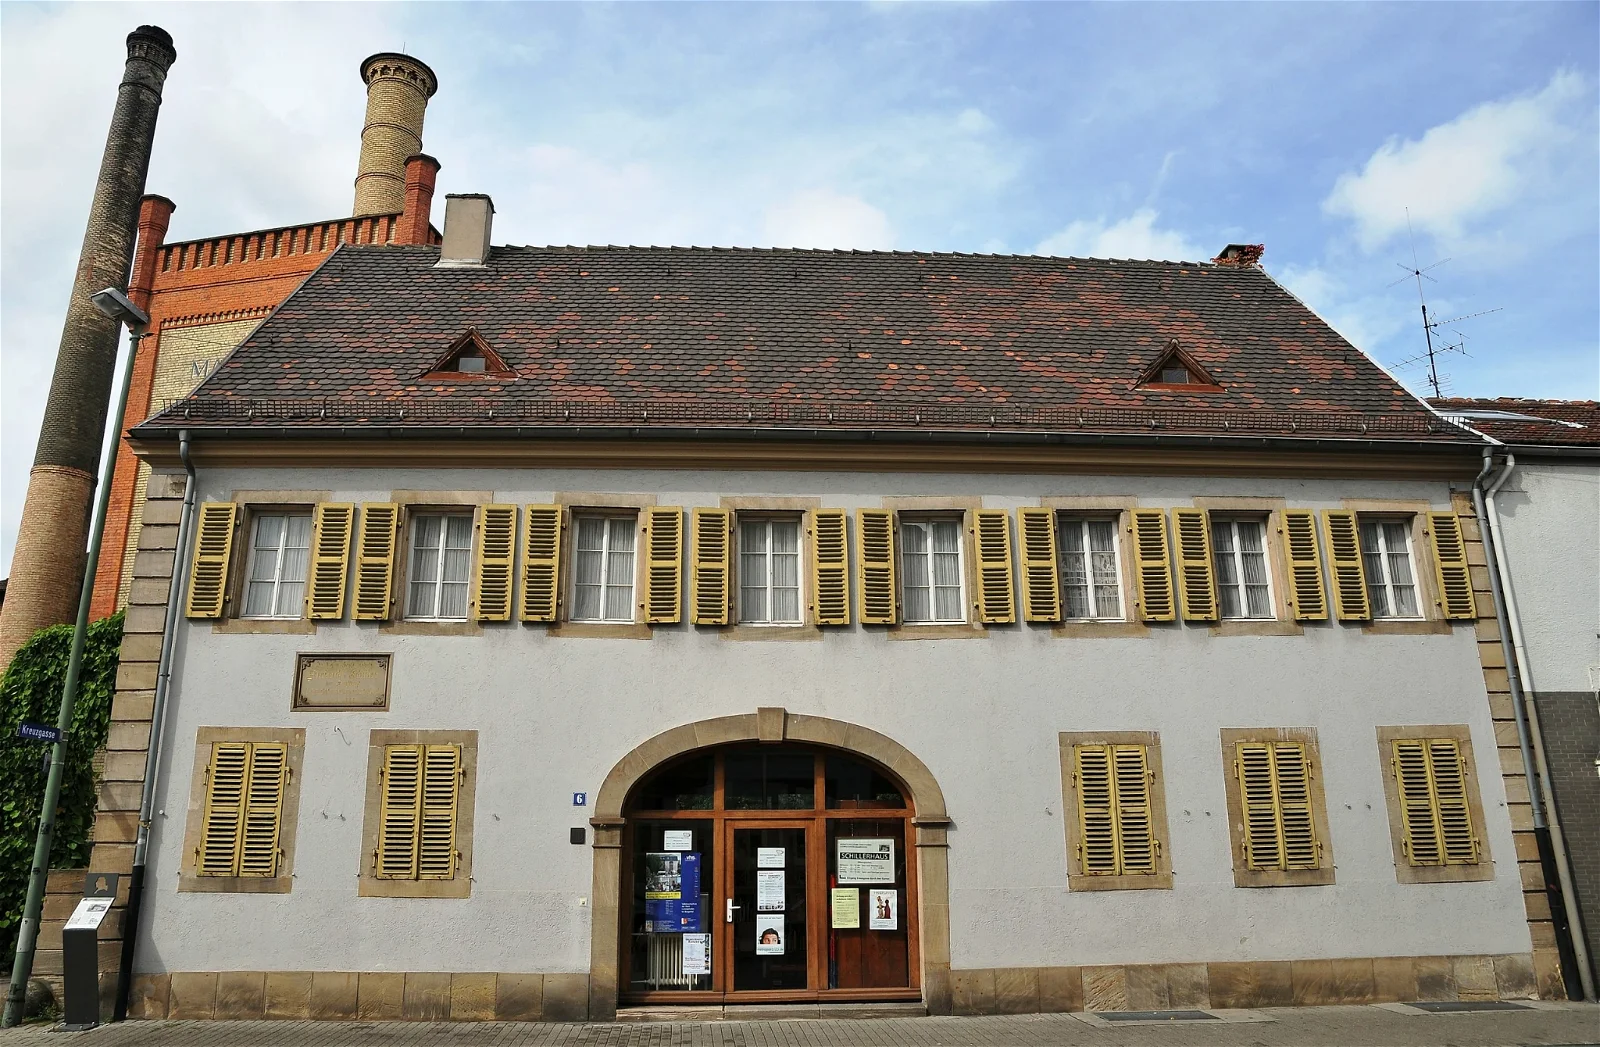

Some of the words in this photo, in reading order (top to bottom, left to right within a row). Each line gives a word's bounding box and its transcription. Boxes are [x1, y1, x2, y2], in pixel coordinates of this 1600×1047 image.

[21, 724, 56, 739] Kreuzgasse
[576, 794, 583, 804] 6
[841, 852, 888, 860] SCHILLERHAUS
